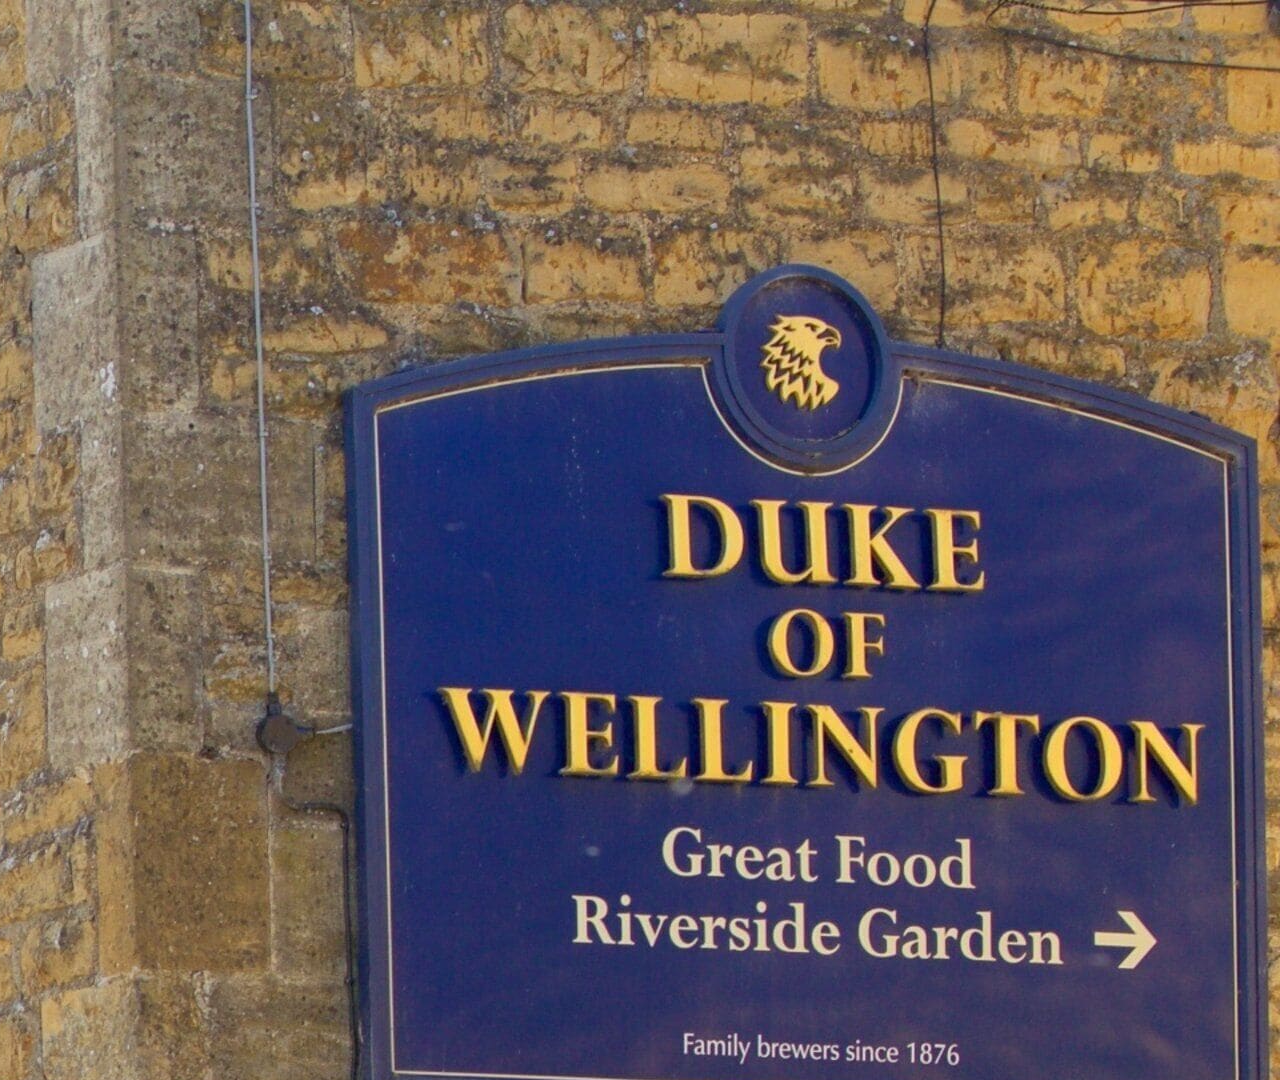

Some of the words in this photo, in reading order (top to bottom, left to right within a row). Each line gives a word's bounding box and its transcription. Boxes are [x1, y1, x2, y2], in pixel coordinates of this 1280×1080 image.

[664, 493, 986, 591] DUKE
[769, 608, 886, 678] OF
[442, 686, 1205, 804] WELLINGTON
[661, 826, 819, 882] Great
[834, 835, 977, 889] Food
[571, 894, 841, 956] Riverside
[857, 907, 1065, 965] Garden
[683, 1032, 751, 1064] Family
[756, 1034, 841, 1062] brewers
[845, 1040, 899, 1063] since
[905, 1042, 960, 1066] 1876
